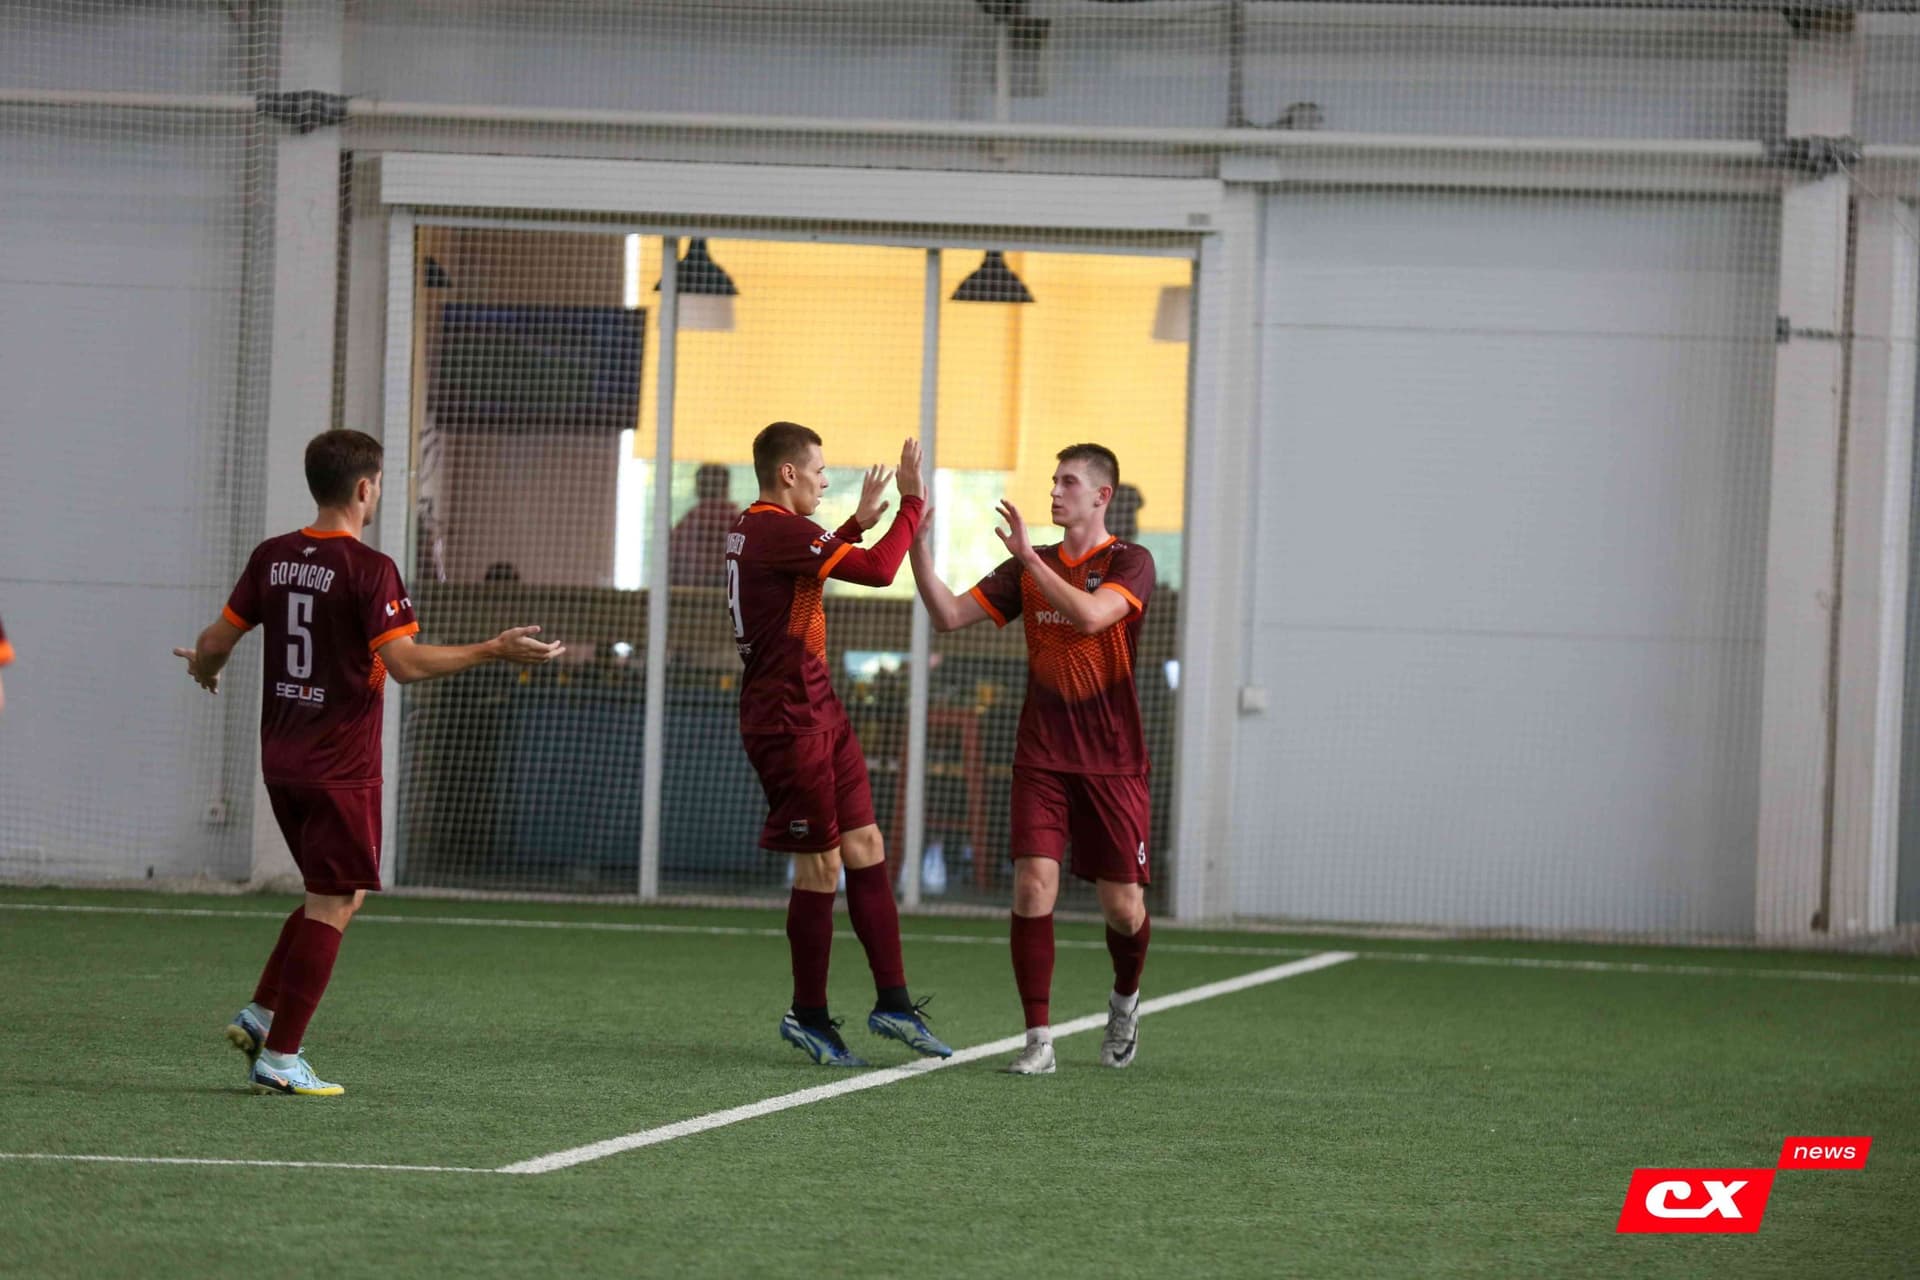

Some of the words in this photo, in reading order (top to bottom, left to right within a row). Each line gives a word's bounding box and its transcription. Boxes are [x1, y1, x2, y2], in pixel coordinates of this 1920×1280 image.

[270, 561, 335, 593] БОРИСОВ
[286, 591, 314, 679] 5
[276, 682, 325, 702] SEUS
